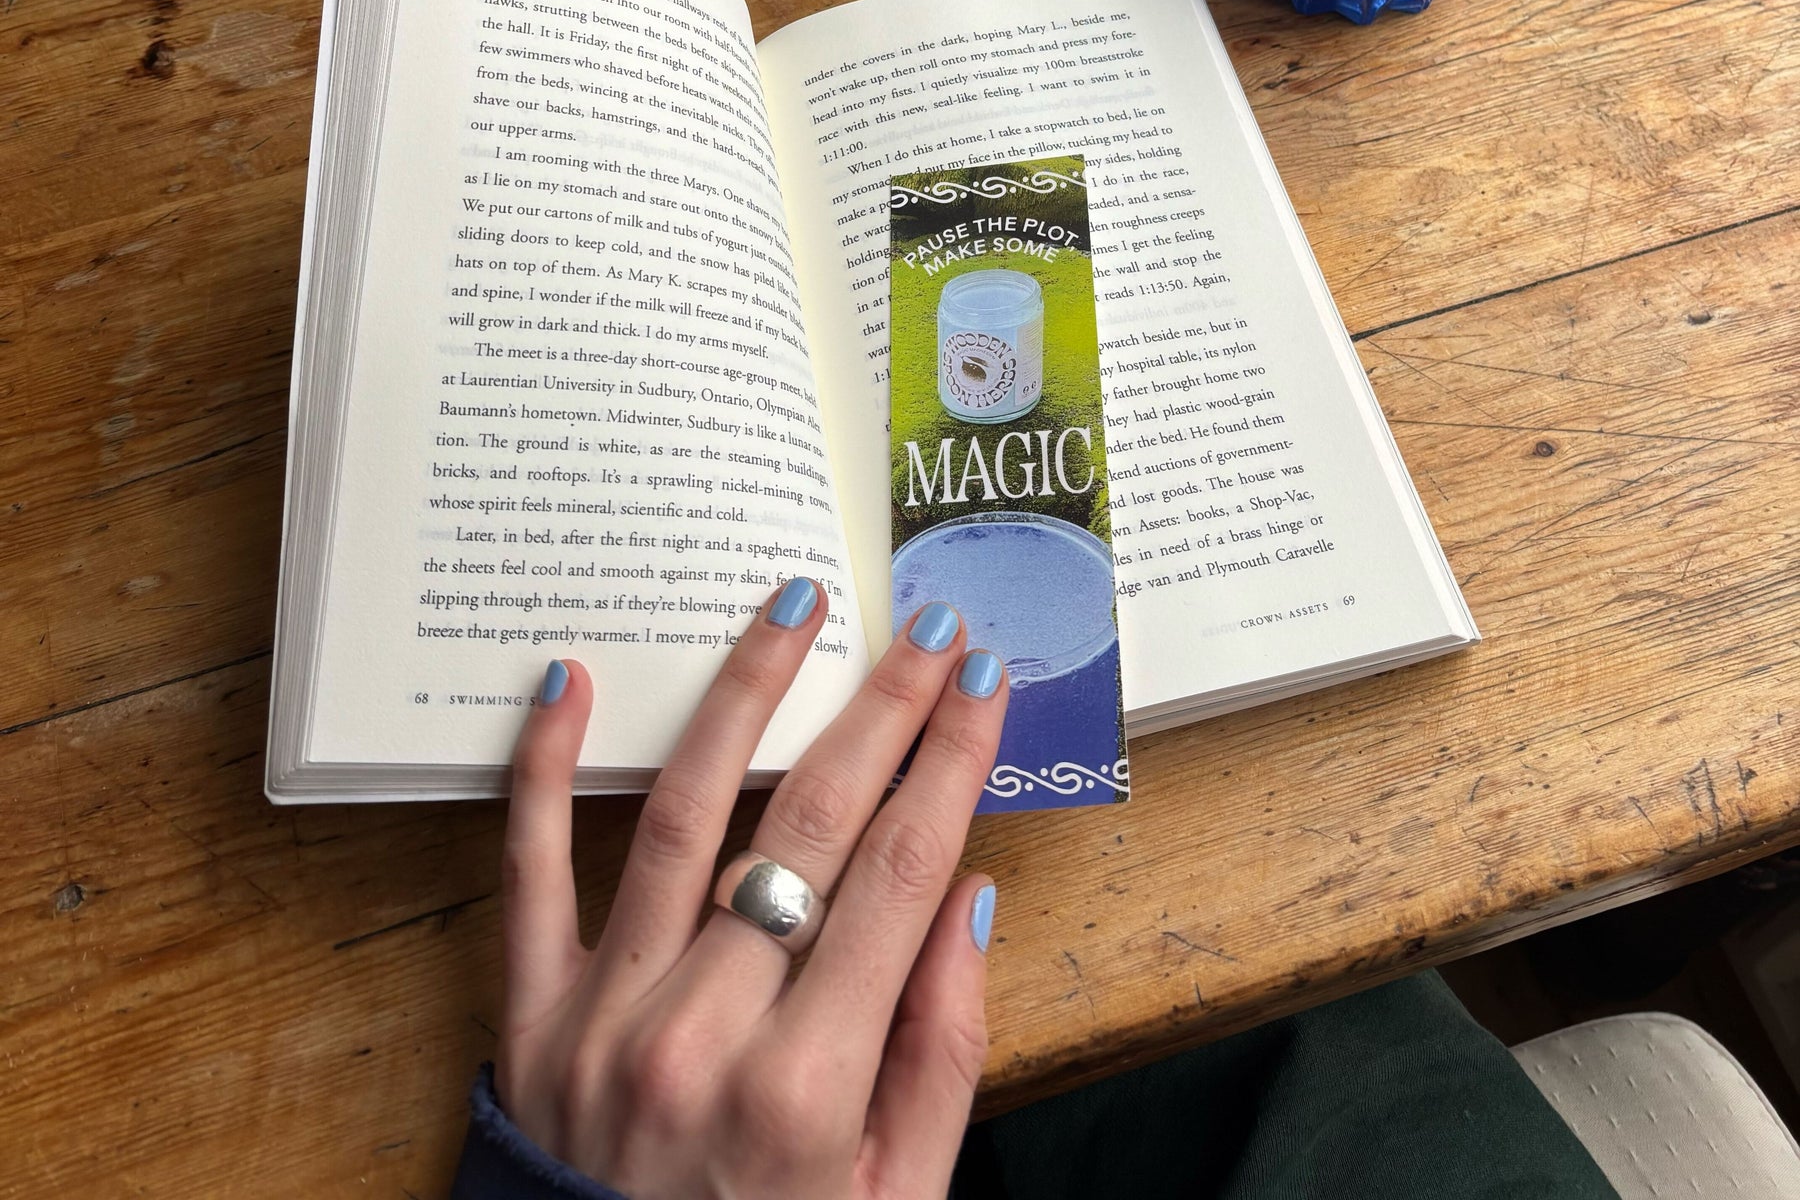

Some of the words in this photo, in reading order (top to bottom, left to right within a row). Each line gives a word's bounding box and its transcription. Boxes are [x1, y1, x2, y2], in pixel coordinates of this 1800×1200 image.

[642, 6, 662, 19] our
[664, 14, 691, 31] room
[692, 26, 713, 42] with
[804, 69, 835, 87] under
[839, 62, 858, 74] the
[862, 51, 896, 66] covers
[900, 46, 913, 56] in
[917, 40, 936, 52] the
[940, 33, 970, 47] dark,
[972, 28, 1014, 42] hoping
[1016, 24, 1046, 36] Mary
[1050, 20, 1068, 31] L.,
[1070, 13, 1106, 28] beside
[1110, 12, 1131, 22] me,
[476, 65, 509, 82] from
[514, 70, 537, 85] the
[540, 73, 574, 92] beds,
[578, 82, 629, 104] wincing
[632, 94, 645, 104] at
[648, 95, 667, 110] the
[670, 100, 720, 128] inevitable
[722, 123, 746, 142] nicks.
[812, 106, 839, 126] head
[841, 101, 865, 114] into
[868, 94, 887, 106] my
[890, 87, 916, 100] fists.
[919, 81, 926, 92] I
[930, 72, 969, 92] quietly
[972, 66, 1019, 80] visualize
[1022, 64, 1040, 76] my
[1044, 58, 1077, 71] 100m
[1078, 47, 1144, 66] breaststroke
[470, 121, 496, 132] our
[498, 124, 539, 139] upper
[540, 129, 577, 142] arms.
[1110, 214, 1169, 231] roughness
[1169, 208, 1206, 221] creeps
[457, 225, 506, 246] sliding
[510, 228, 550, 246] doors
[555, 236, 570, 247] to
[574, 234, 606, 255] keep
[610, 240, 643, 257] cold,
[648, 246, 672, 260] and
[677, 248, 697, 264] the
[700, 257, 730, 272] snow
[733, 261, 750, 278] has
[753, 271, 776, 289] piled
[903, 222, 970, 270] PAUSE
[972, 216, 1017, 234] THE
[1022, 217, 1080, 253] PLOT,
[922, 239, 987, 277] MAKE
[992, 237, 1060, 264] SOME
[1104, 285, 1135, 301] reads
[1138, 278, 1188, 296] 1:13:50.
[1192, 272, 1231, 290] Again,
[945, 333, 1012, 359] WOODEN
[1116, 353, 1166, 374] hospital
[1168, 349, 1202, 365] table,
[1202, 347, 1220, 360] its
[1222, 341, 1257, 359] nylon
[473, 342, 504, 358] The
[506, 348, 544, 360] meet
[546, 346, 558, 361] is
[560, 351, 570, 361] a
[573, 347, 638, 370] three-day
[640, 352, 720, 376] short-course
[722, 367, 778, 392] age-group
[943, 352, 972, 406] SPOON
[976, 358, 1017, 408] HERBS
[441, 375, 457, 386] at
[459, 371, 538, 389] Laurentian
[543, 374, 616, 398] University
[619, 379, 634, 394] in
[637, 380, 697, 404] Sudbury,
[700, 387, 754, 410] Ontario,
[756, 396, 806, 424] Olympian
[1104, 415, 1129, 429] hey
[1132, 406, 1159, 423] had
[1162, 400, 1203, 422] plastic
[1204, 388, 1276, 410] wood-grain
[1136, 434, 1158, 449] the
[1158, 428, 1188, 445] bed.
[1188, 425, 1211, 440] He
[1211, 416, 1251, 436] found
[1251, 414, 1286, 429] them
[436, 431, 469, 448] tion.
[478, 432, 509, 449] The
[515, 435, 570, 454] ground
[578, 436, 590, 452] is
[597, 438, 641, 456] white,
[649, 445, 664, 456] as
[671, 447, 692, 458] are
[700, 444, 721, 461] the
[727, 452, 782, 474] steaming
[786, 457, 829, 488] buildings,
[904, 426, 1095, 507] MAGIC
[1143, 457, 1197, 475] auctions
[1199, 449, 1214, 465] of
[1215, 440, 1294, 466] government-
[428, 493, 476, 510] whose
[477, 496, 518, 516] spirit
[520, 495, 553, 513] feels
[556, 498, 616, 517] mineral,
[619, 500, 684, 518] scientific
[686, 504, 714, 520] and
[716, 506, 748, 523] cold.
[1138, 516, 1181, 533] Assets:
[1185, 504, 1230, 523] books,
[1235, 504, 1245, 514] a
[1248, 488, 1315, 511] Shop-Vac,
[455, 526, 497, 545] Later,
[502, 527, 518, 543] in
[524, 527, 555, 546] bed,
[560, 528, 596, 546] after
[600, 530, 624, 547] the
[628, 530, 658, 548] first
[662, 533, 701, 554] night
[704, 536, 731, 552] and
[734, 542, 744, 553] a
[746, 541, 802, 561] spaghetti
[805, 546, 840, 570] dinner,
[1146, 575, 1172, 588] van
[1176, 564, 1203, 583] and
[1204, 551, 1272, 578] Plymouth
[1274, 538, 1335, 562] Caravelle
[423, 556, 448, 574] the
[450, 557, 496, 575] sheets
[500, 558, 526, 576] feel
[530, 560, 562, 576] cool
[567, 561, 596, 578] and
[599, 563, 655, 579] smooth
[659, 565, 710, 585] against
[714, 572, 737, 587] my
[739, 568, 772, 588] skin,
[1240, 612, 1283, 629] CROWN
[1289, 602, 1329, 619] ASSETS
[1342, 594, 1356, 606] 69
[414, 692, 430, 705] 68
[448, 694, 522, 706] SWIMMING
